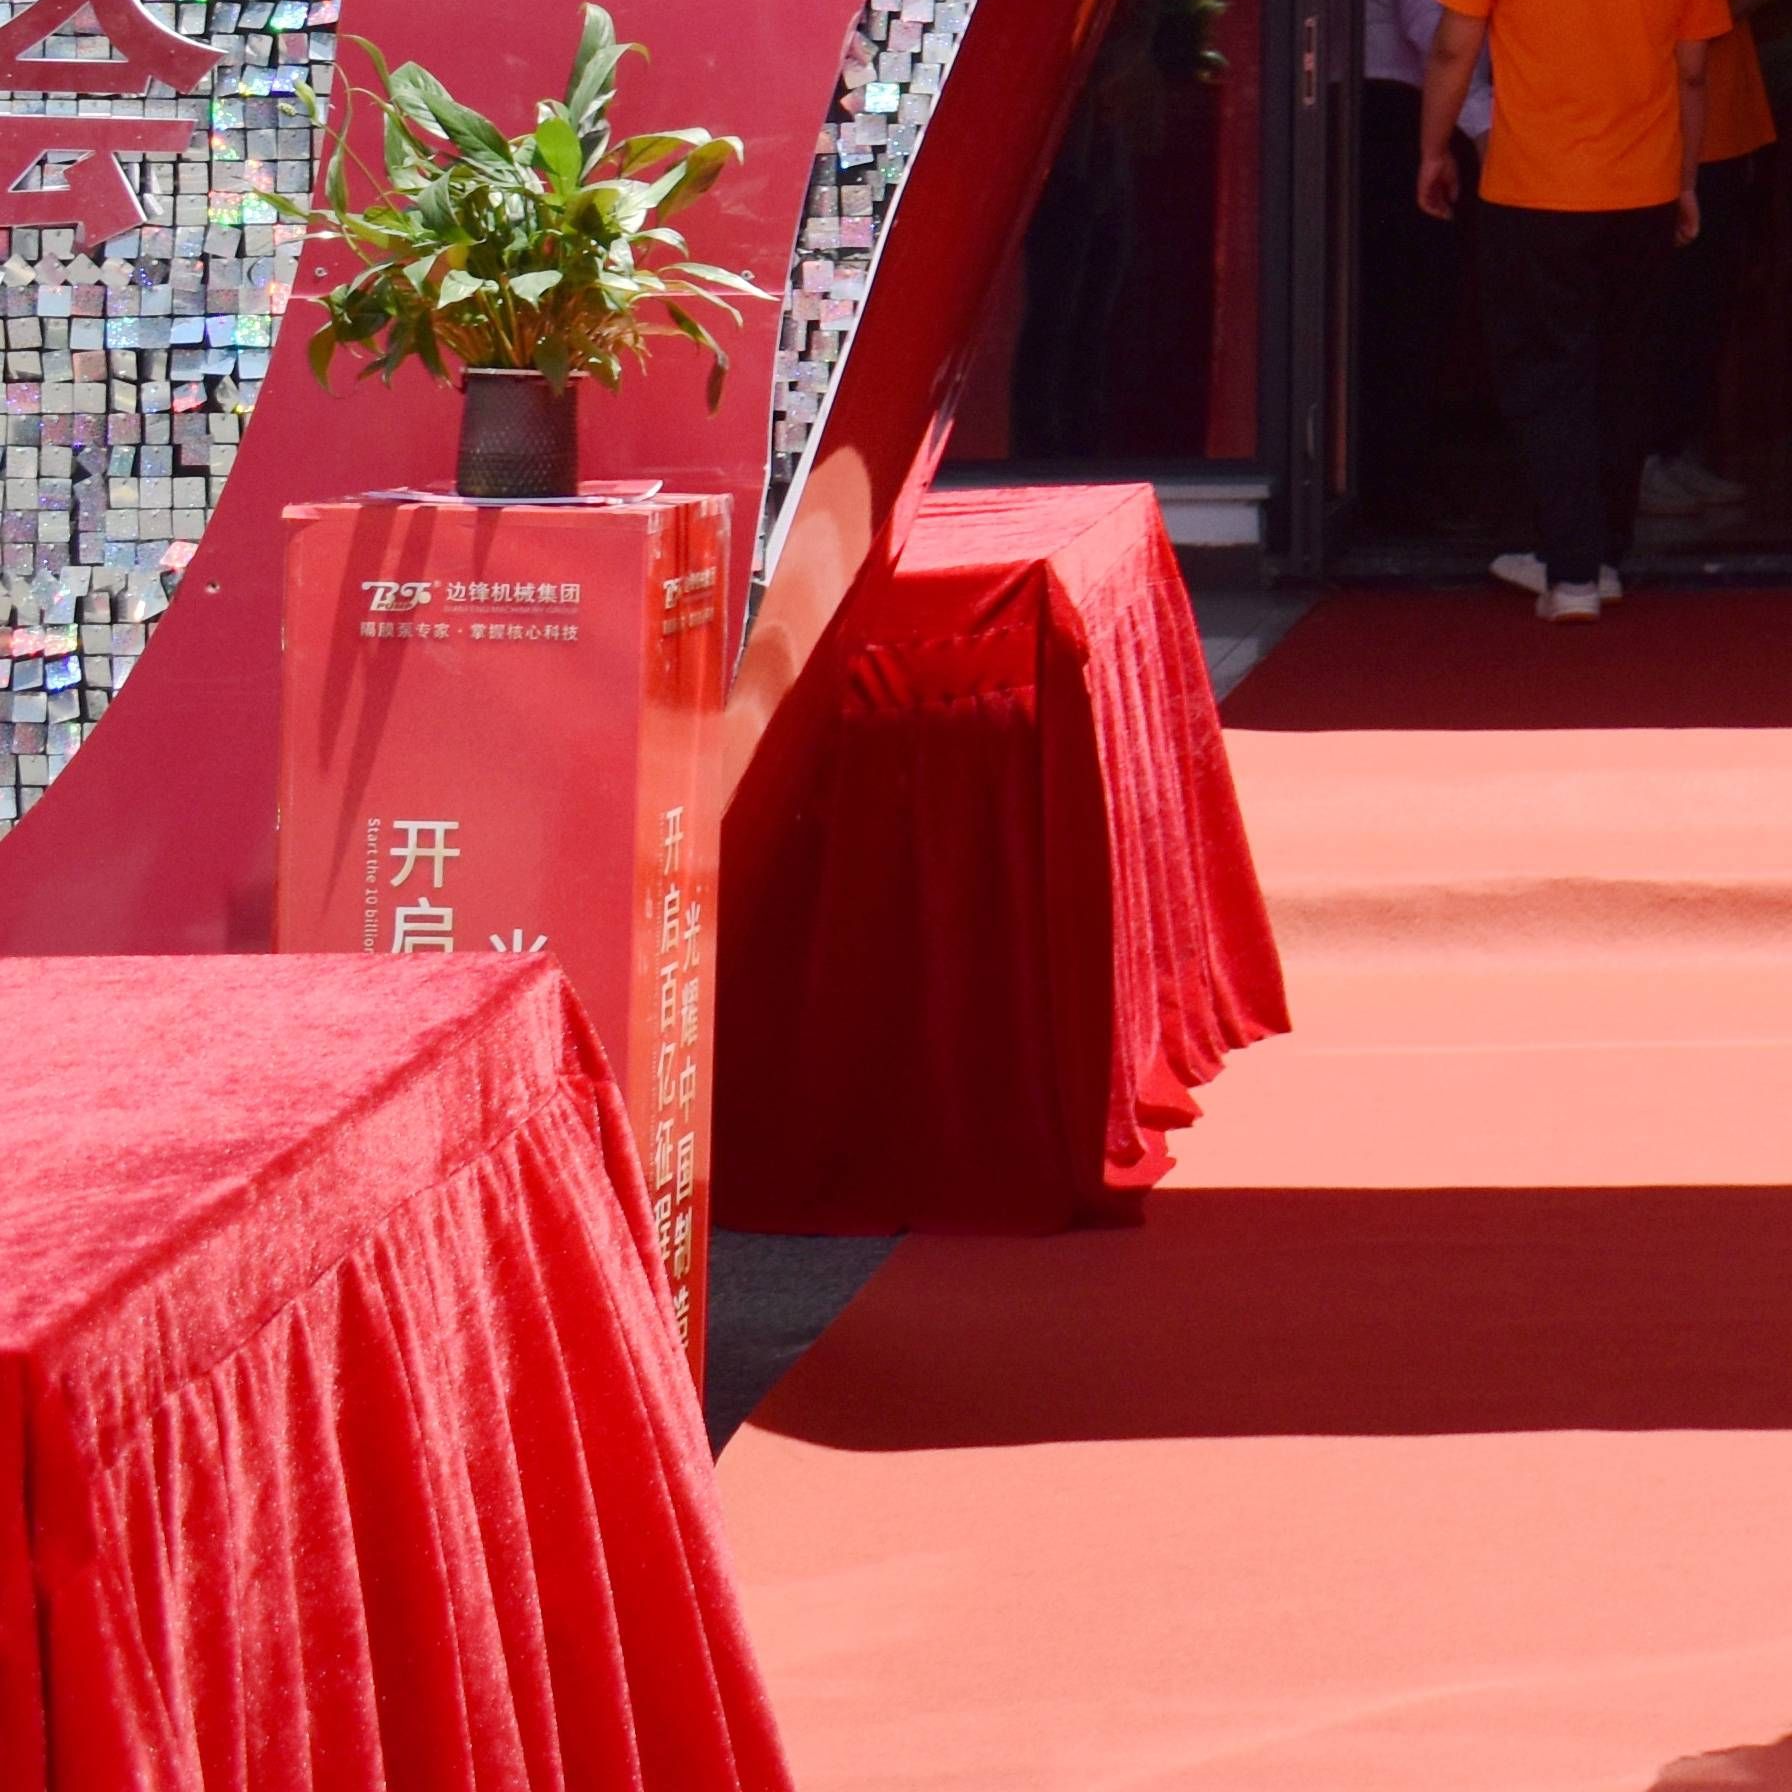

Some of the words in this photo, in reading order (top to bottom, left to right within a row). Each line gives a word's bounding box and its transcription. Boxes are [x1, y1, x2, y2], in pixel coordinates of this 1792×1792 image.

[447, 582, 581, 605] 边锋机械集团
[367, 818, 381, 855] Start
[366, 859, 379, 883] the
[366, 888, 378, 905] 10
